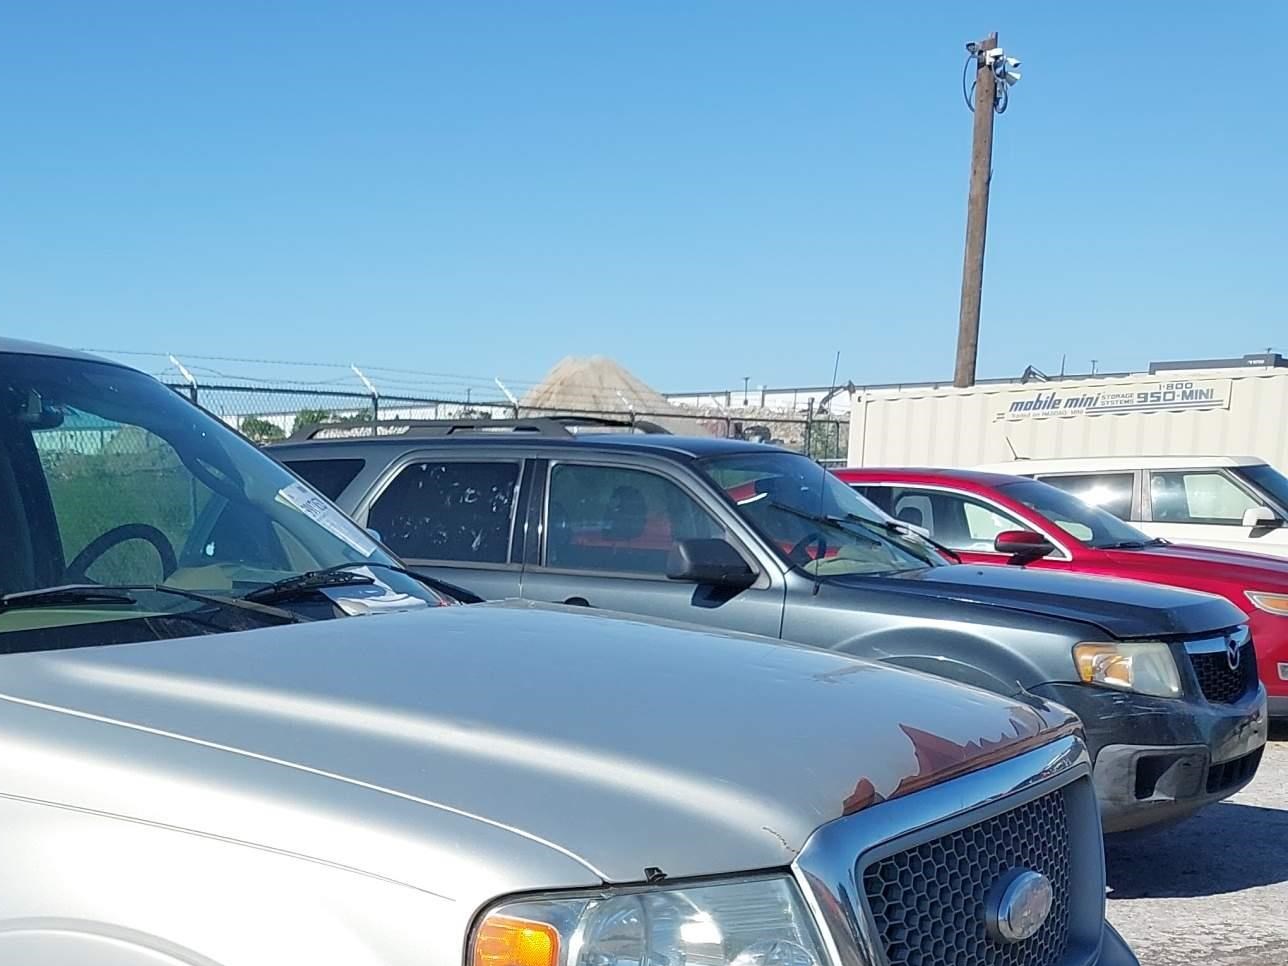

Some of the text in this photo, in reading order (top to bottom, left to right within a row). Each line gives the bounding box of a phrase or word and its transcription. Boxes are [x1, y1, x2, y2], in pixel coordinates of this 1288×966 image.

[1101, 392, 1134, 401] STORAGE
[1009, 392, 1101, 412] mobile mini
[1100, 399, 1134, 407] SYSTEMS
